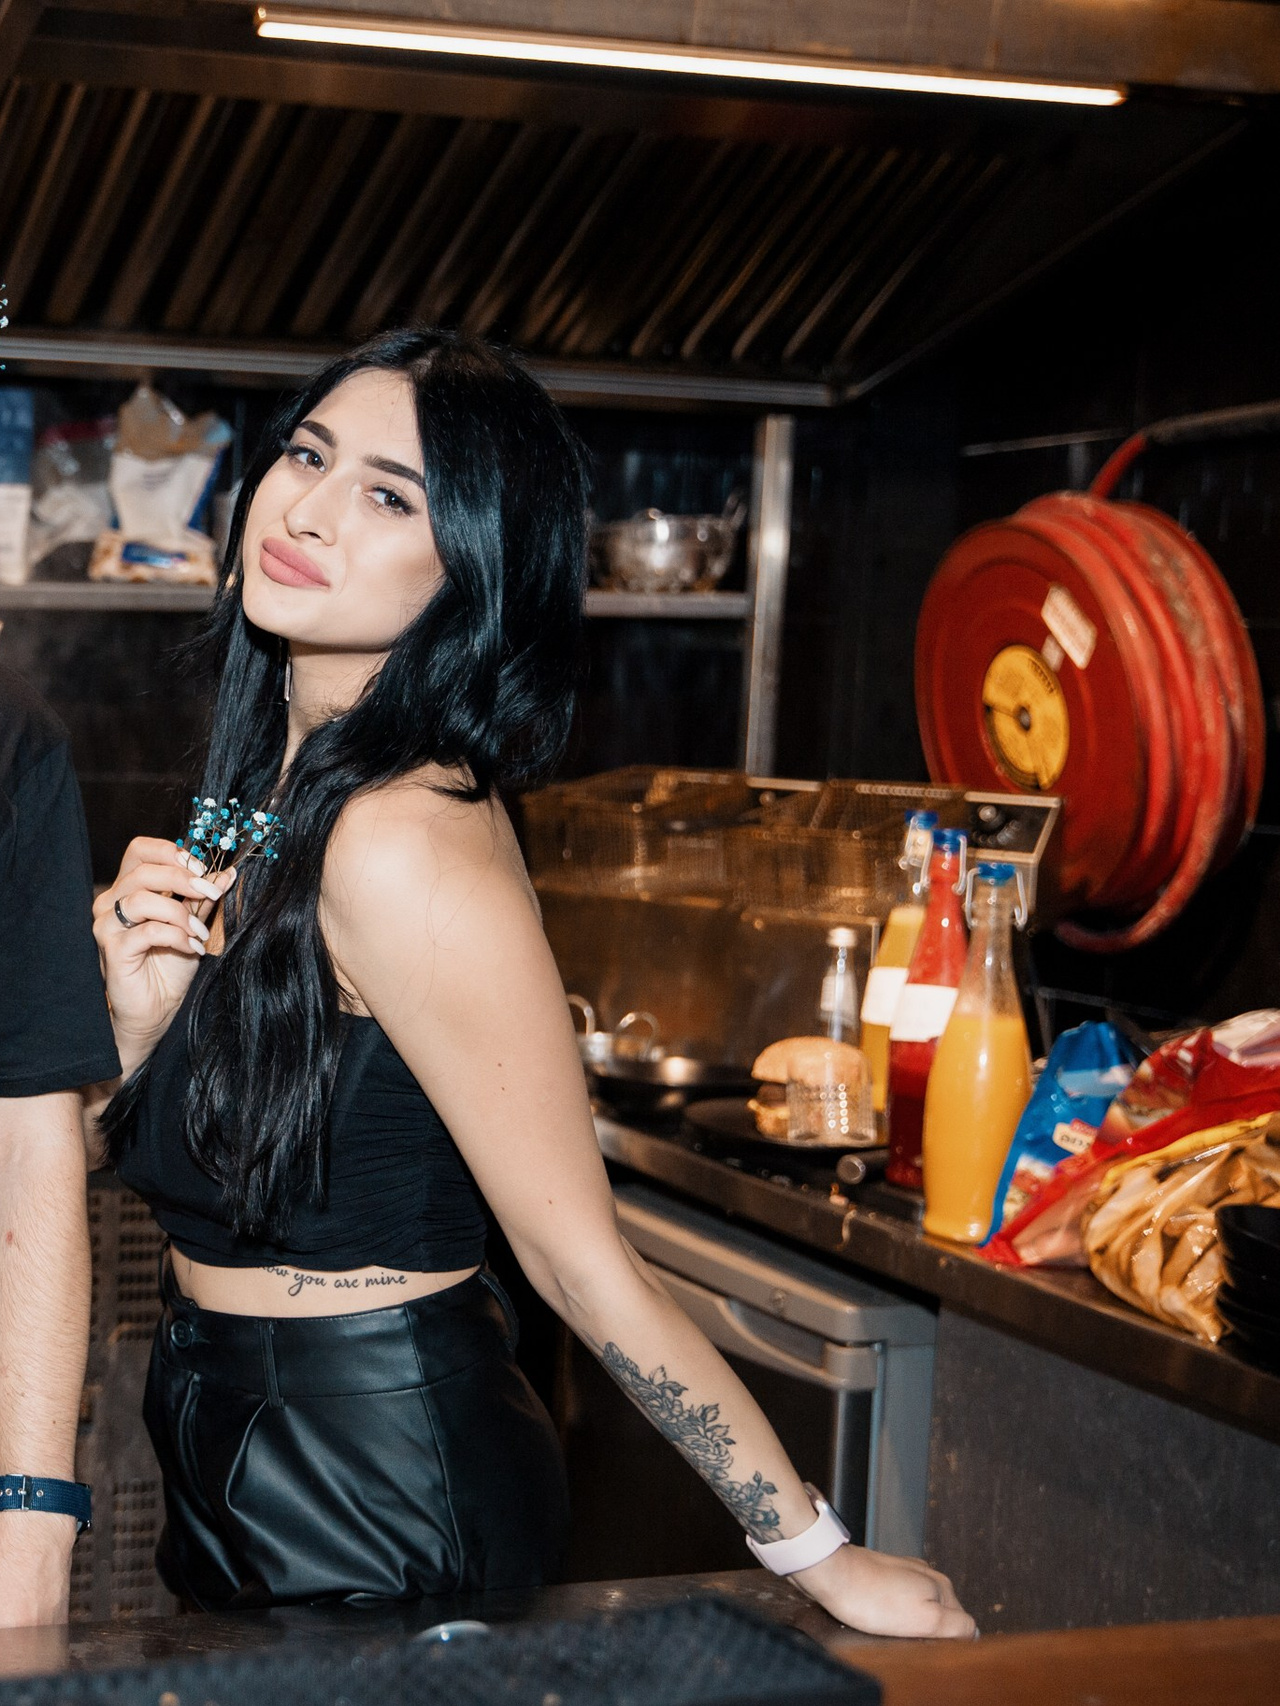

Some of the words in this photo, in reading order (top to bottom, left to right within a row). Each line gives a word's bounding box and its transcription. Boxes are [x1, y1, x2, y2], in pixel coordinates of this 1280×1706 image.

[288, 1272, 327, 1297] you
[334, 1278, 360, 1289] are
[365, 1271, 408, 1288] mine
